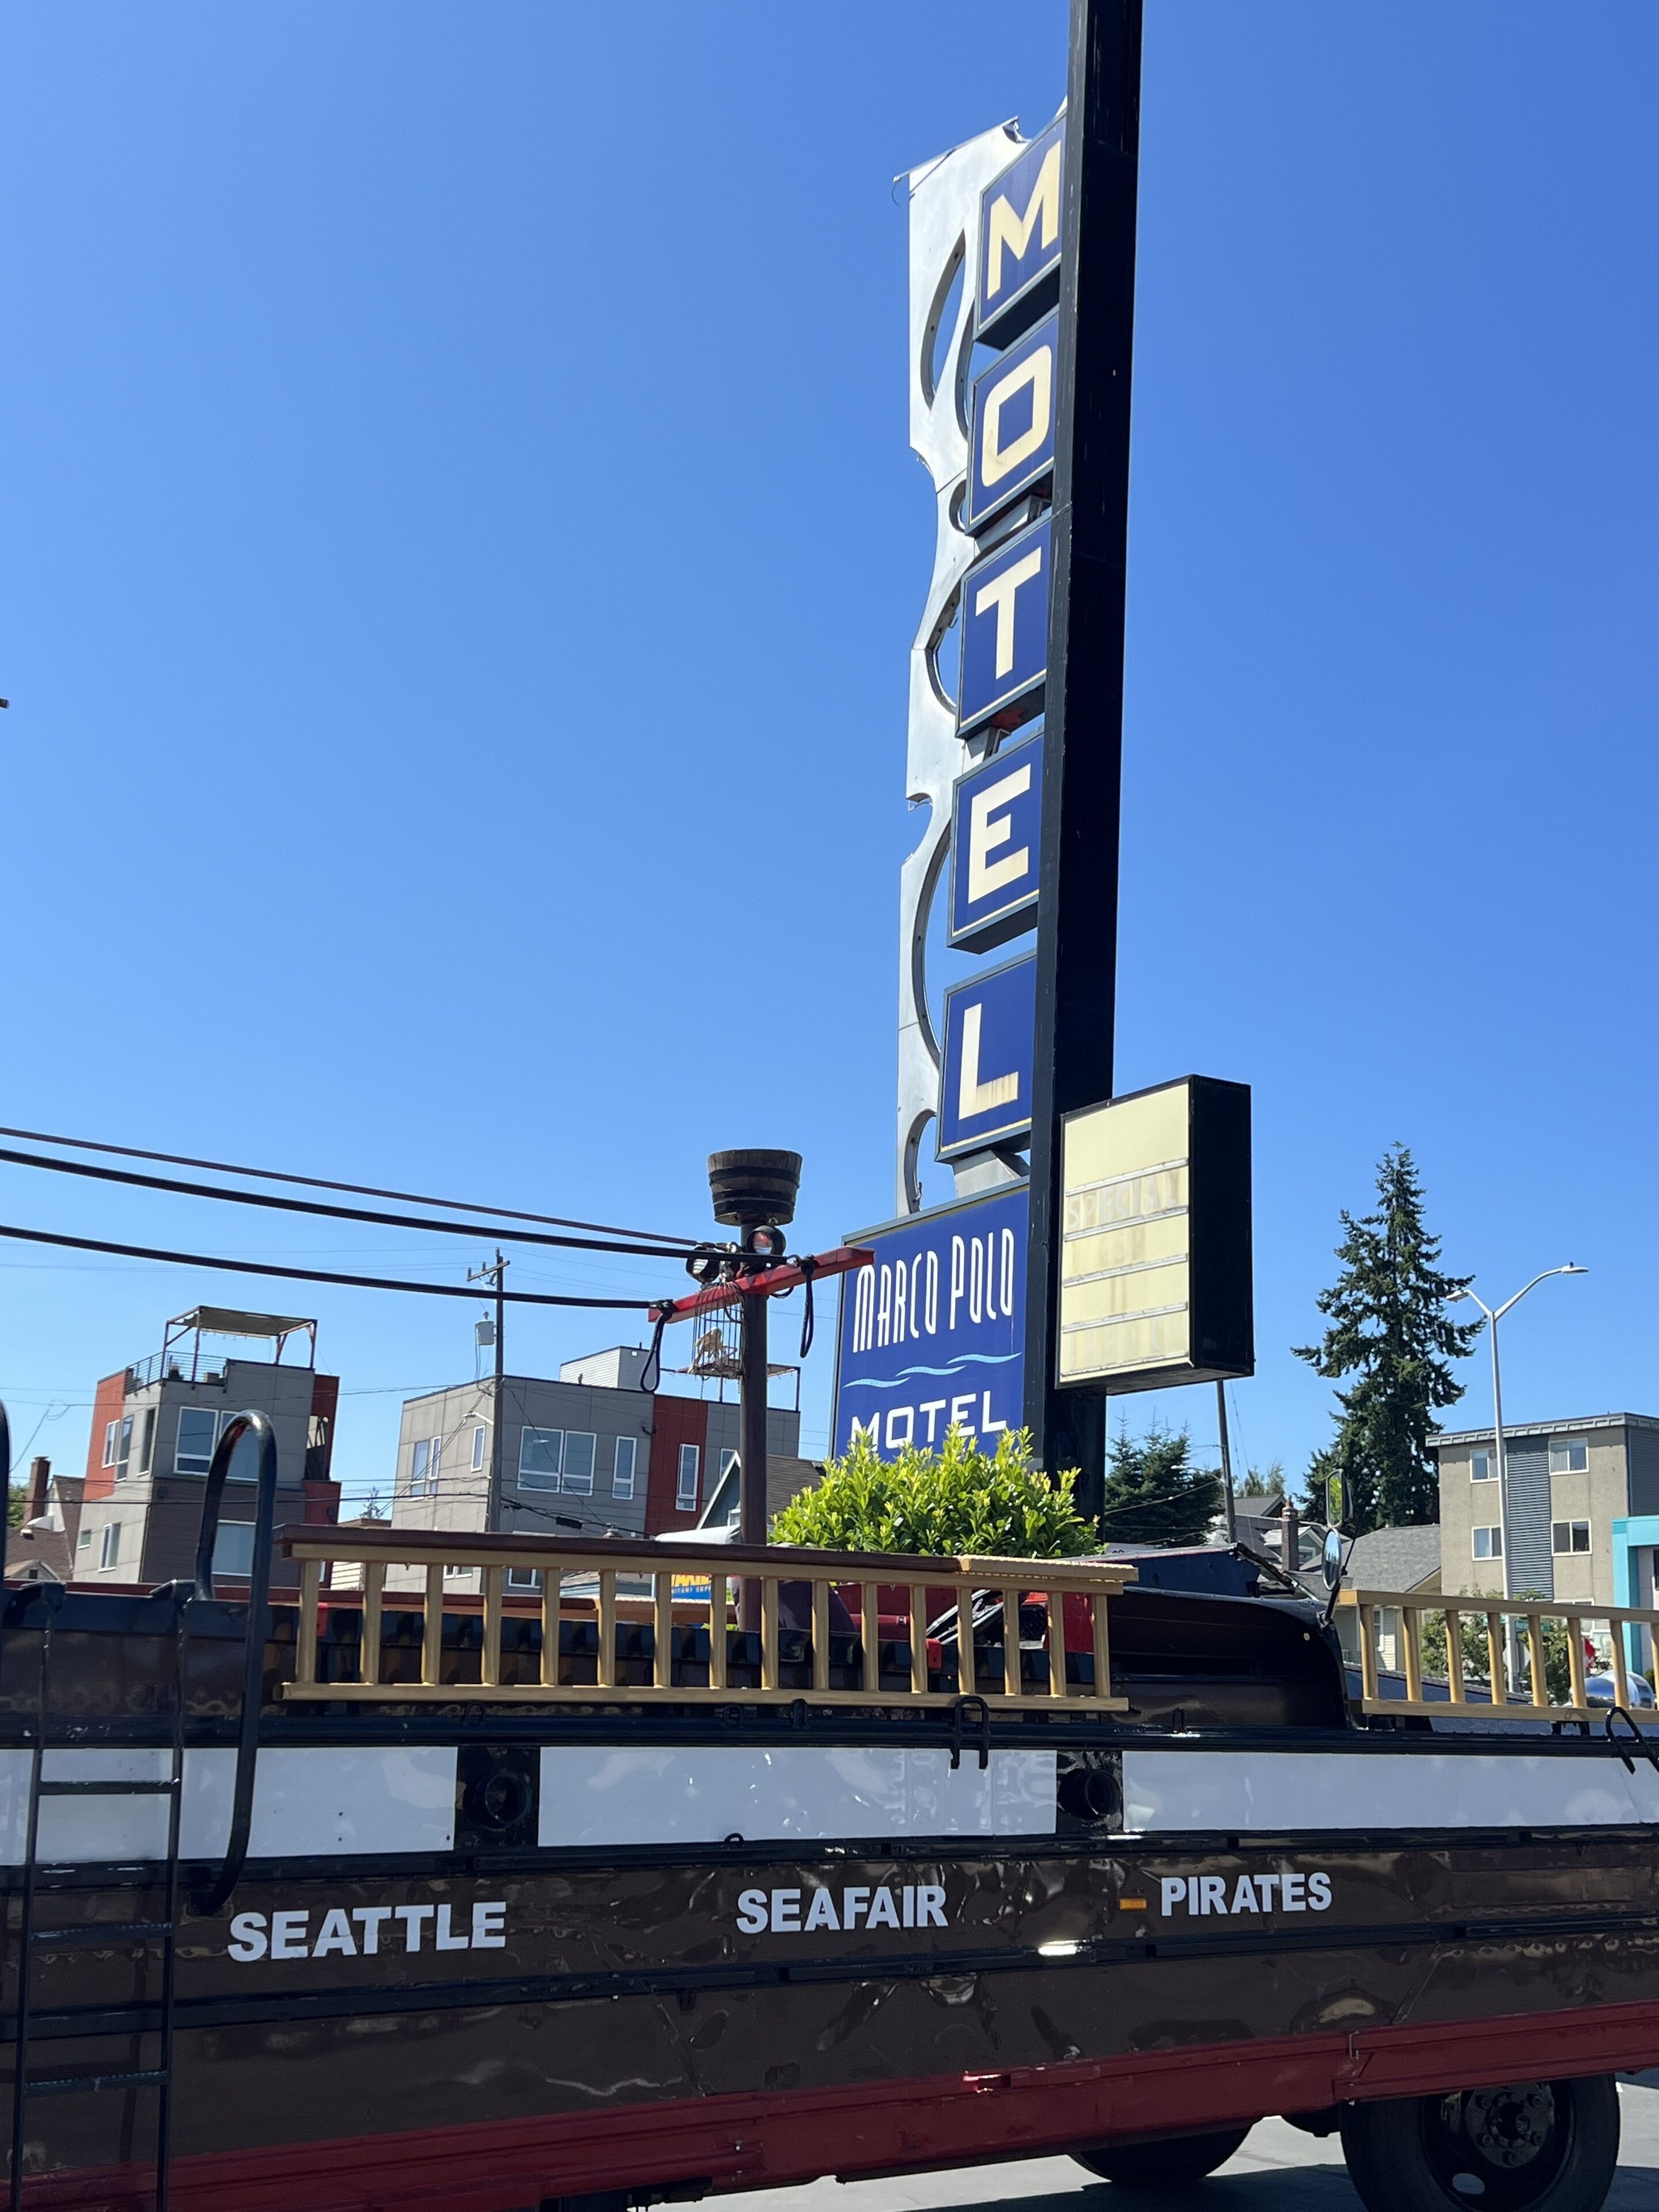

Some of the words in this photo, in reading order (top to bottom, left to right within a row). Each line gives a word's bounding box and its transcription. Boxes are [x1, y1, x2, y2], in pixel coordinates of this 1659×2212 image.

[958, 139, 1062, 1120] MOTEL
[853, 1251, 938, 1353] MARCO
[950, 1228, 1014, 1330] POLO
[851, 1390, 1007, 1452] MOTEL
[228, 1902, 506, 1961] SEATTLE
[737, 1881, 949, 1933] SEAFAIR
[1161, 1872, 1332, 1916] PIRATES
